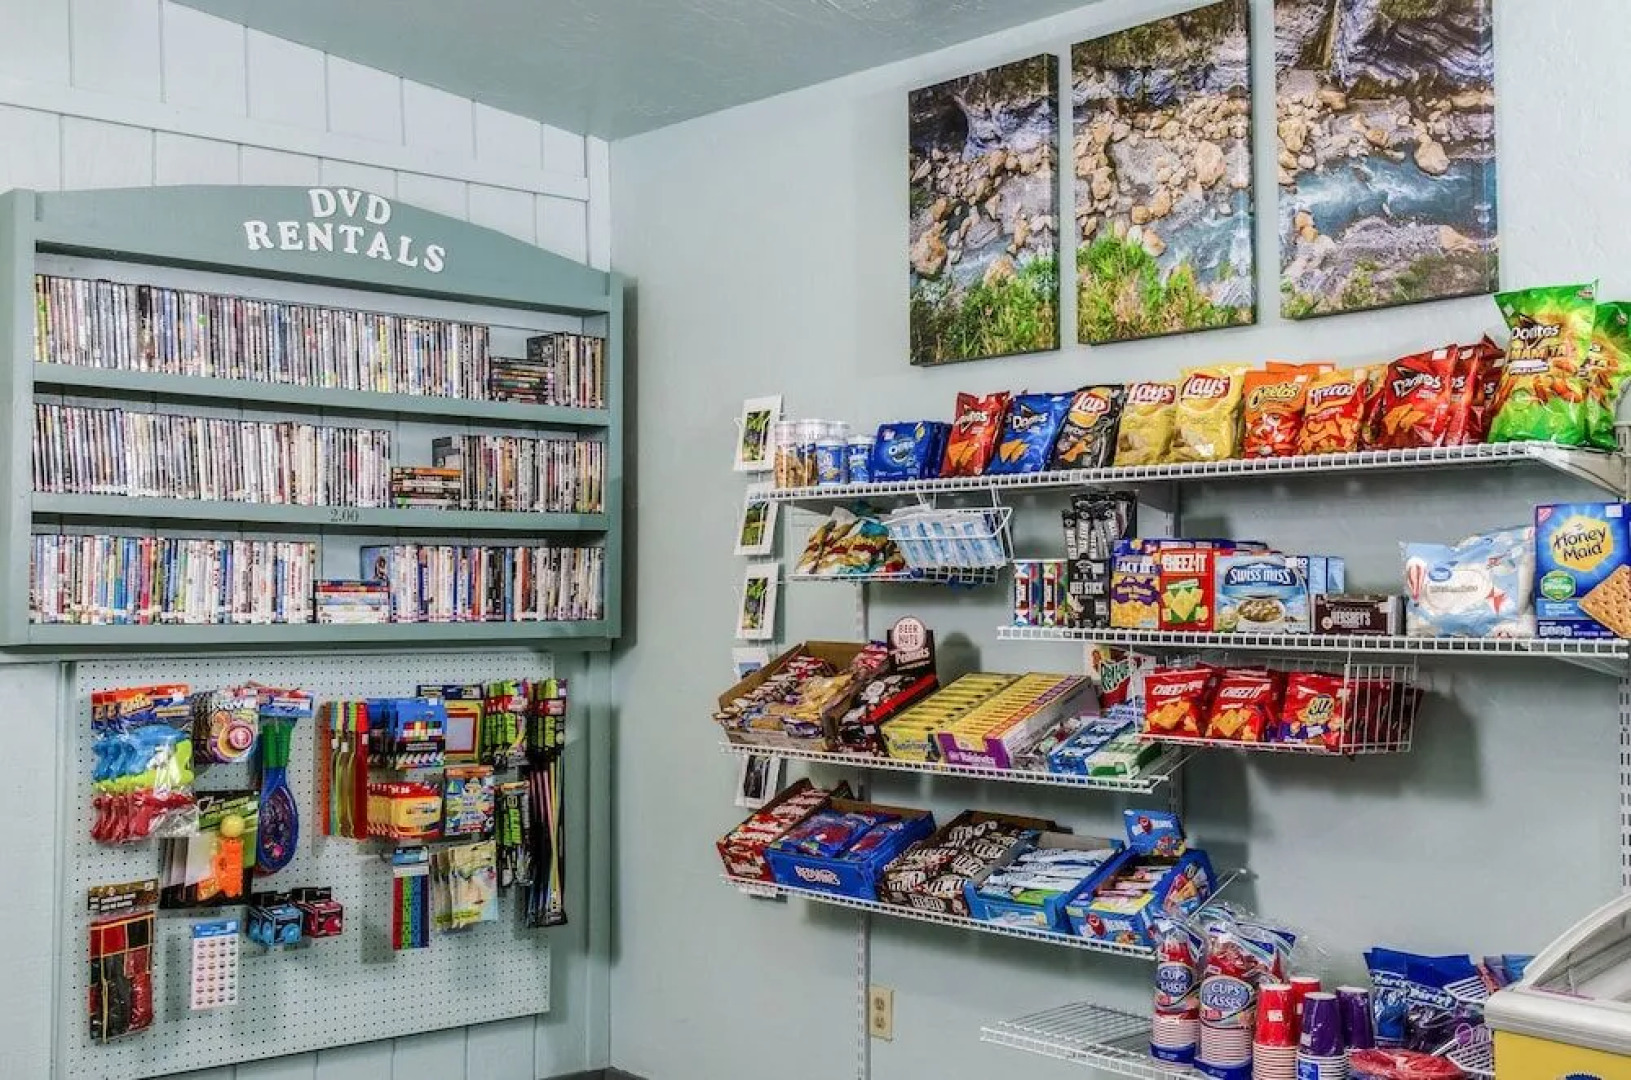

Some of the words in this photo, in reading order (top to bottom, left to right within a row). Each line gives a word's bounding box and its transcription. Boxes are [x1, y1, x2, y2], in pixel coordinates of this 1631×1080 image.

[308, 188, 391, 225] DVD
[243, 220, 446, 273] RENTALS
[330, 508, 360, 523] 2.00
[1552, 526, 1606, 548] Honey
[1562, 544, 1603, 563] Maid
[1211, 983, 1241, 996] CUPS
